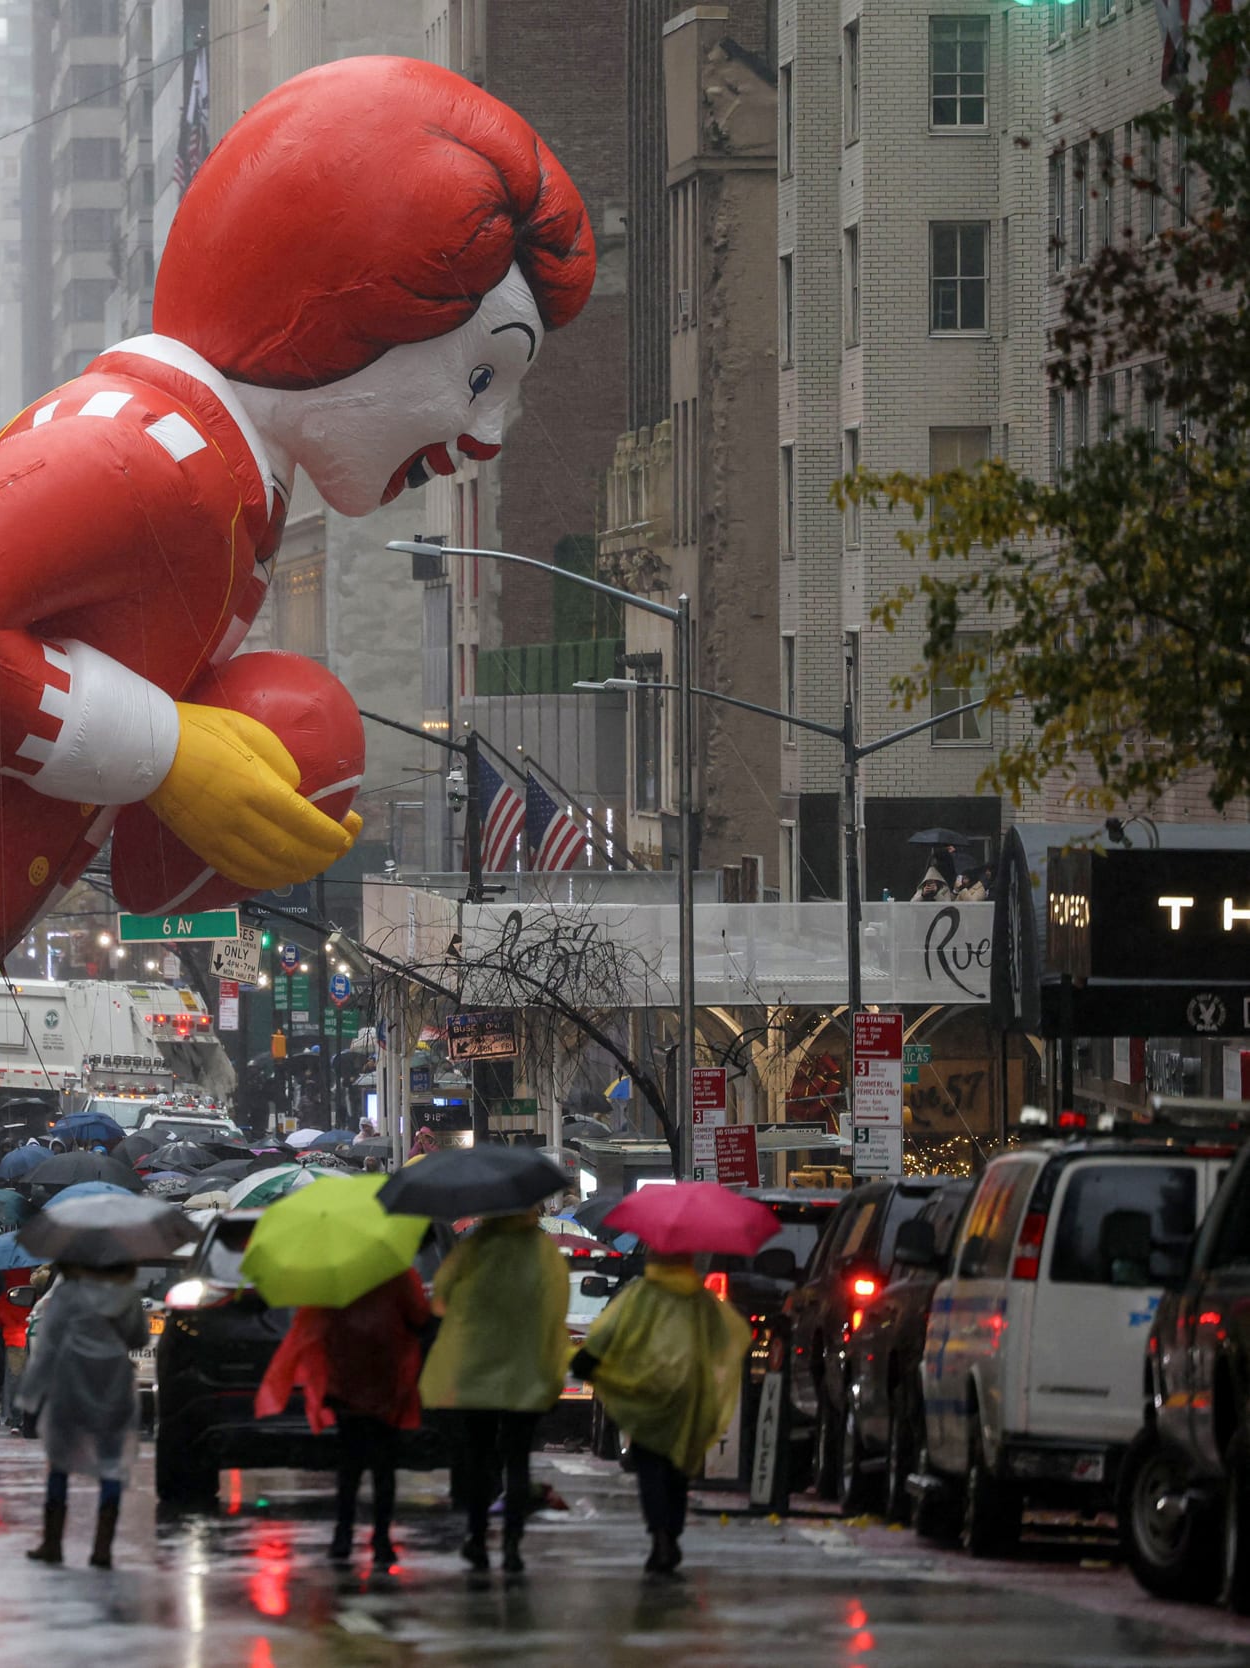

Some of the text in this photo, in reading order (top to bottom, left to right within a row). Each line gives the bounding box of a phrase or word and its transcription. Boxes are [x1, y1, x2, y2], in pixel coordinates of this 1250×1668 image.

[162, 917, 193, 935] 6 Av
[224, 945, 250, 961] ONLY
[923, 906, 993, 999] Rue
[223, 969, 235, 978] MON
[856, 1016, 896, 1025] NO STANDING
[858, 1062, 866, 1075] 3
[856, 1081, 893, 1089] COMMERCIAL
[856, 1088, 884, 1096] VEHICLES
[695, 1110, 702, 1123] 3
[858, 1128, 866, 1143] 5
[695, 1168, 703, 1181] 5
[758, 1383, 777, 1494] VALET
